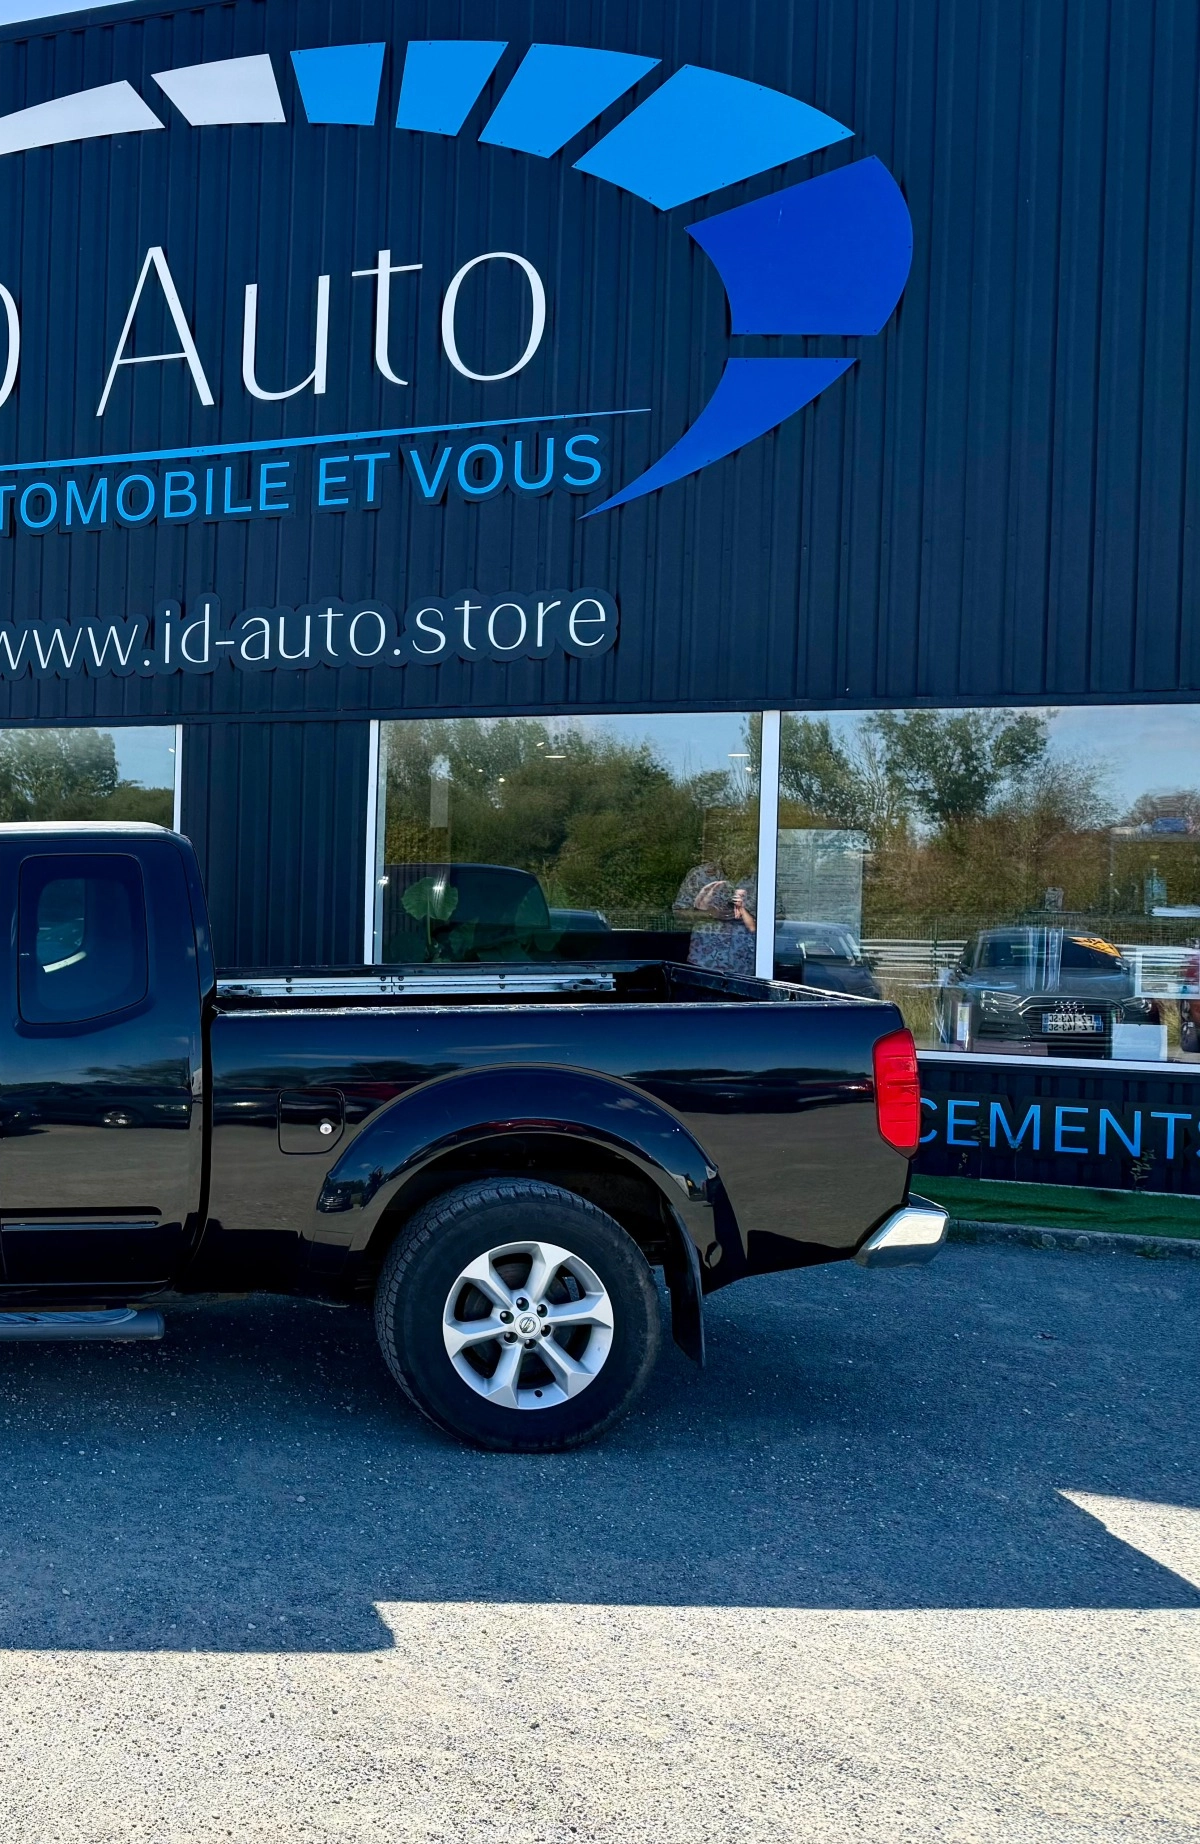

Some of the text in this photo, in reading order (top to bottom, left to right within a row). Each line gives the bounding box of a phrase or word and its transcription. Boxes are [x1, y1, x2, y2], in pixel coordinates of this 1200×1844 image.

[96, 245, 547, 417] Auto
[317, 451, 391, 507] ET
[409, 433, 603, 498] VOUS
